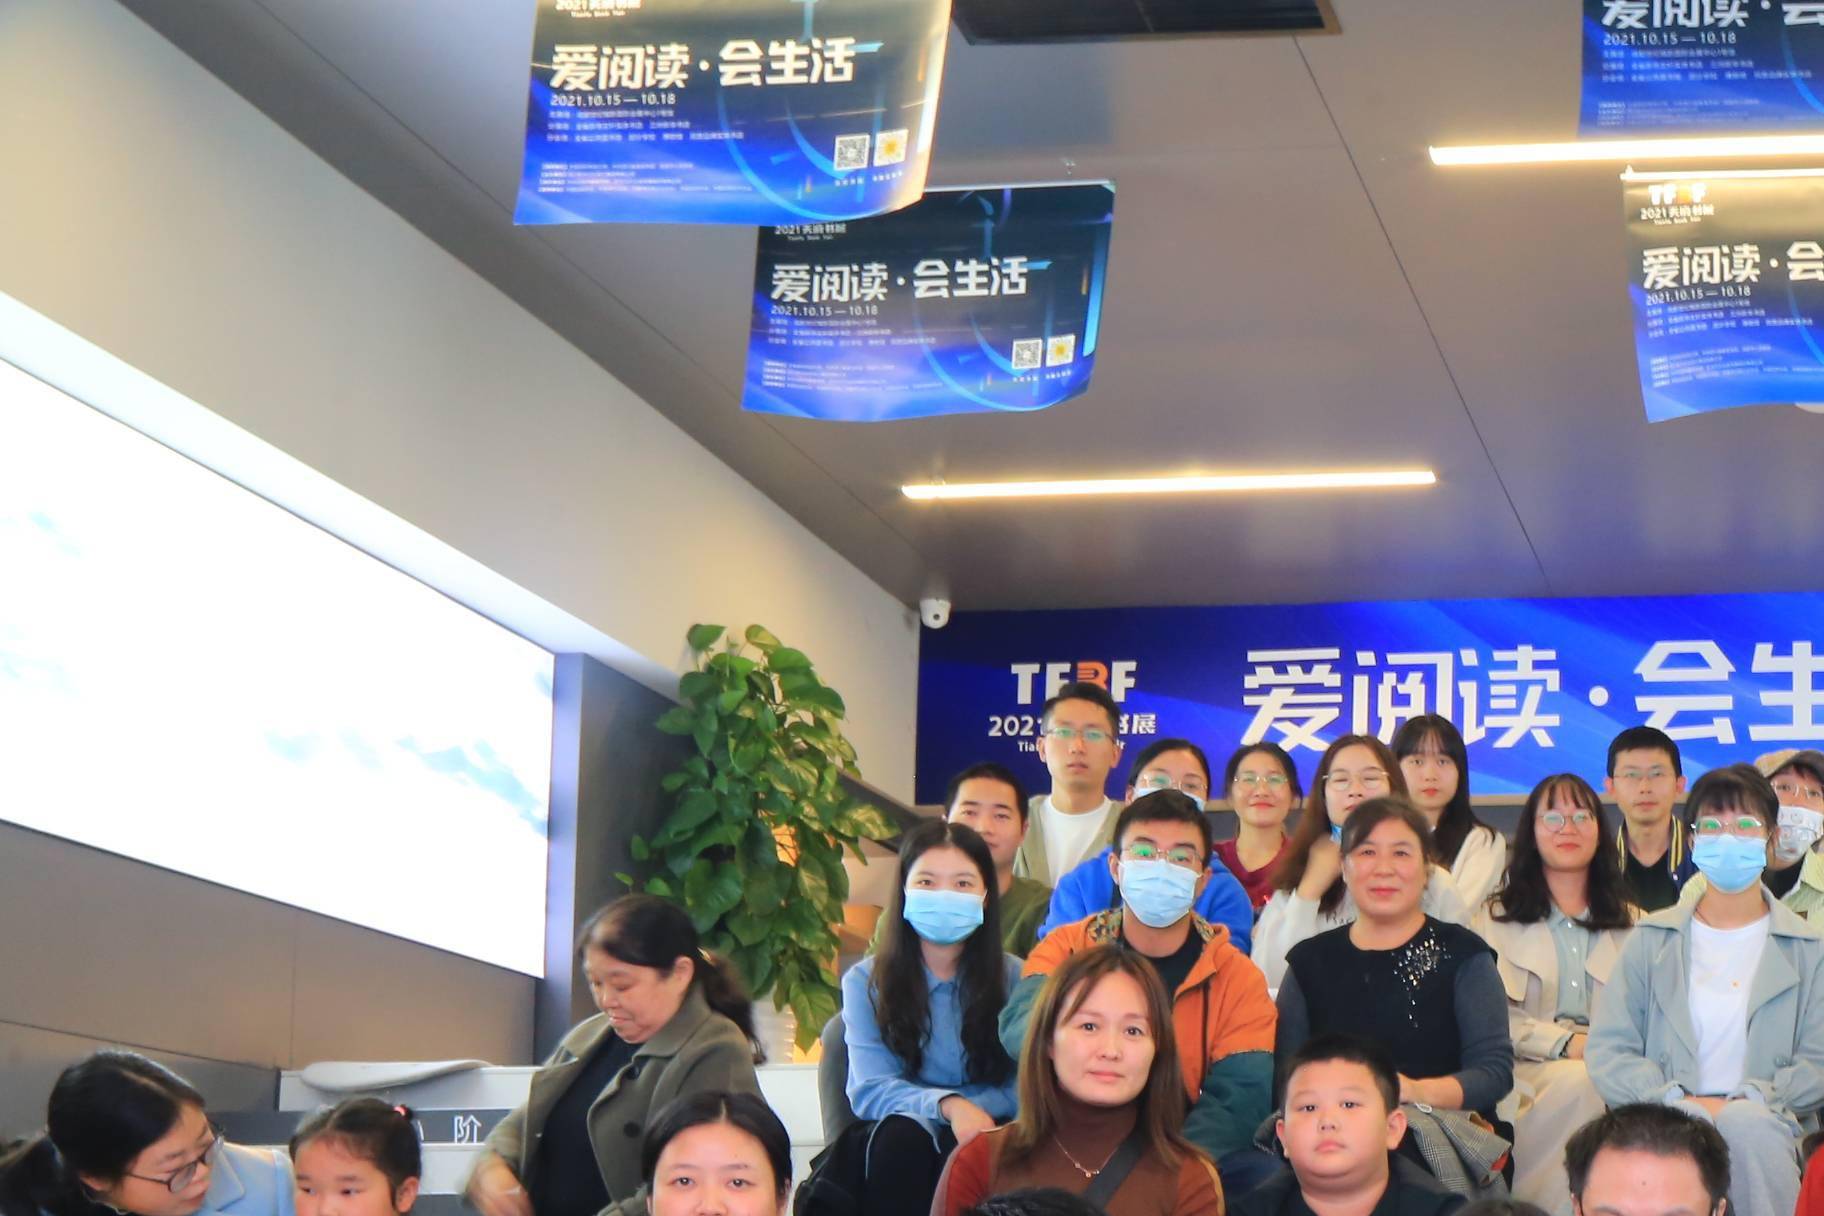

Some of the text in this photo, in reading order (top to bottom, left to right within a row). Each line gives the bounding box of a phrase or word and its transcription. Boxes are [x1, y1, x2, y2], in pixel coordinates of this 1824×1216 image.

[551, 38, 855, 91] 爱阅读·会生活
[771, 256, 1029, 303] 爱阅读·会生活
